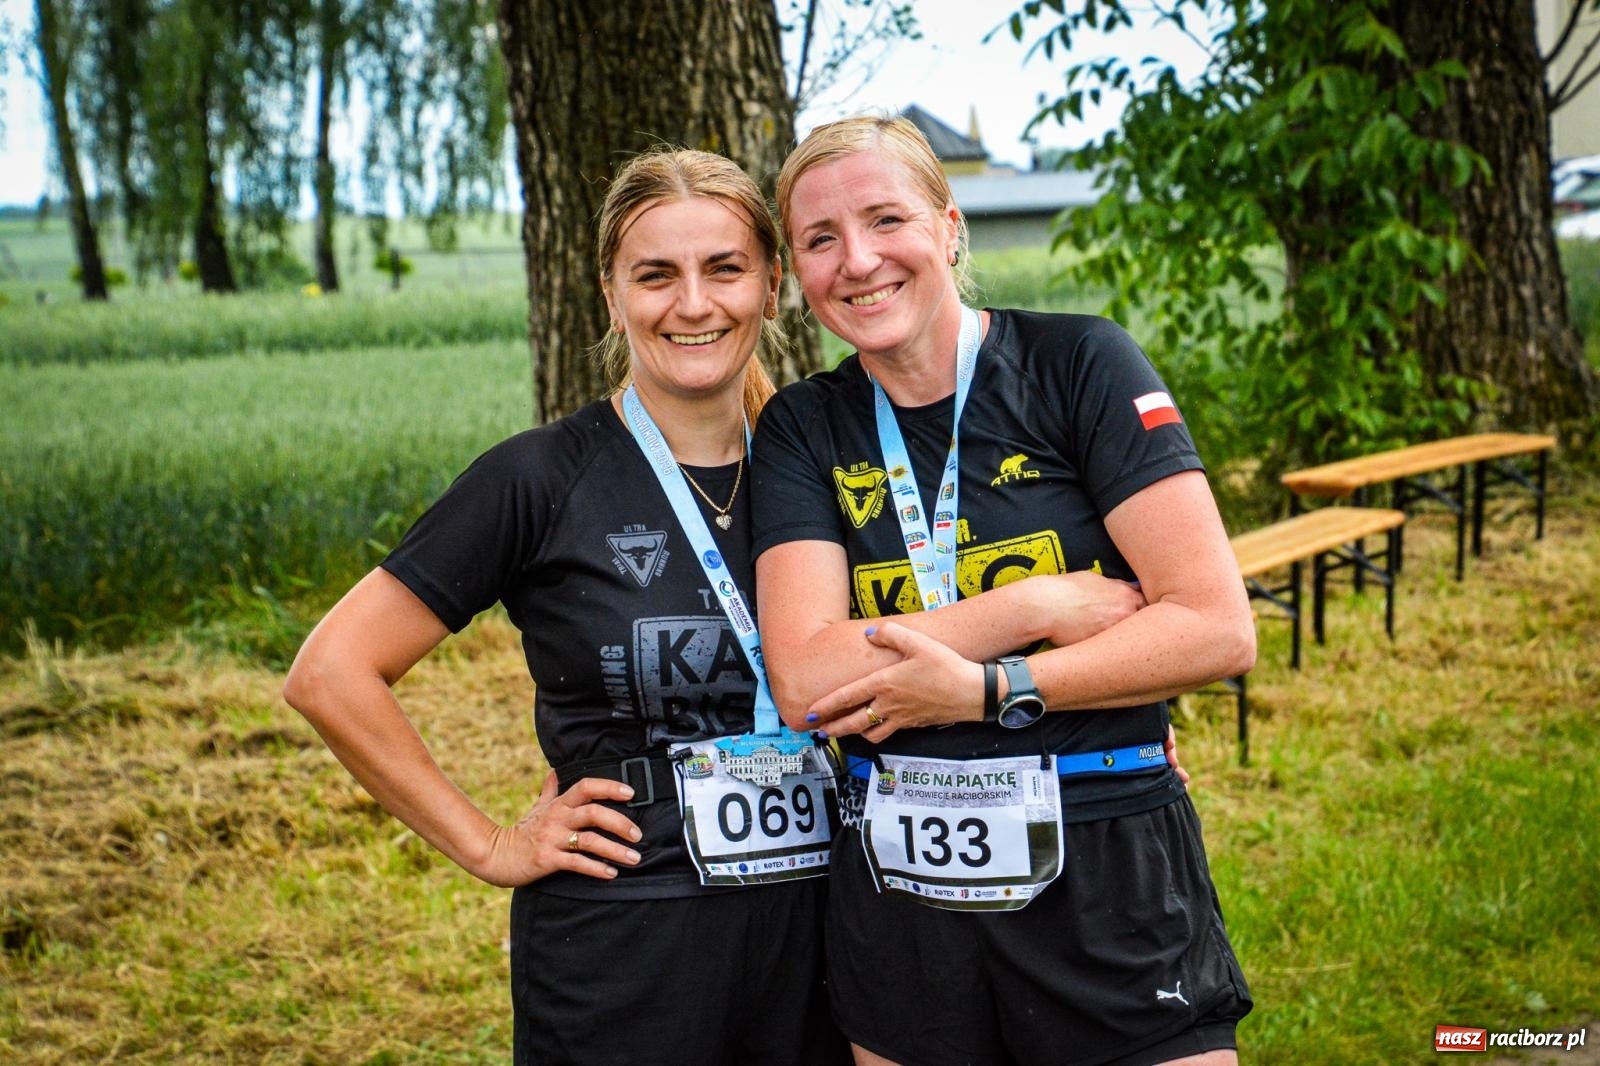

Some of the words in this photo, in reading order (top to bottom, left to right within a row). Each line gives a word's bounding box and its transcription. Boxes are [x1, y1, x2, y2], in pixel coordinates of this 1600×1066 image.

[623, 524, 647, 533] ULTRA
[732, 596, 752, 632] AKADEMIA
[901, 771, 930, 785] BIEG
[933, 773, 953, 787] NA
[956, 772, 1017, 790] PIĄTKĘ
[904, 789, 914, 797] PO
[914, 790, 950, 800] POWIECIE
[951, 791, 1012, 800] RACIBORSKIM
[717, 784, 815, 842] 069
[898, 815, 992, 868] 133
[763, 861, 785, 869] ROTEX
[934, 889, 955, 897] ROTEX
